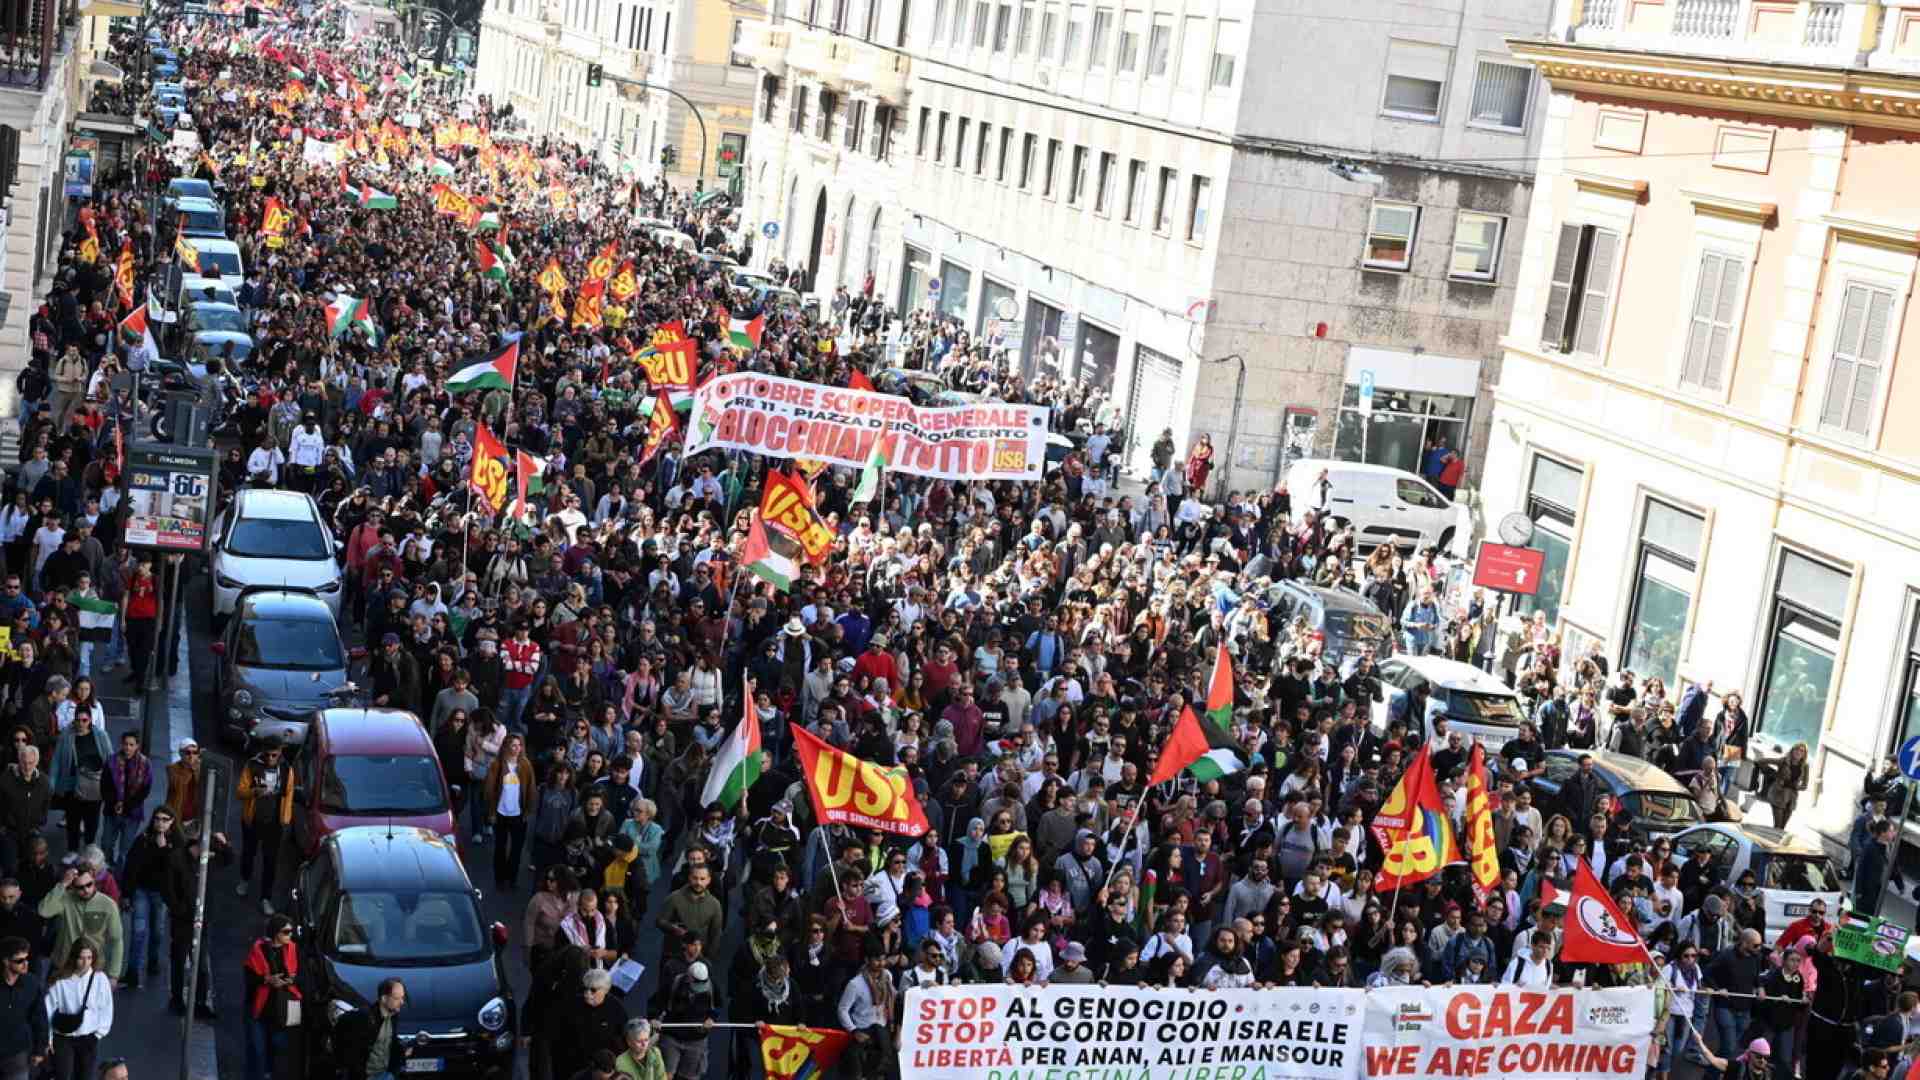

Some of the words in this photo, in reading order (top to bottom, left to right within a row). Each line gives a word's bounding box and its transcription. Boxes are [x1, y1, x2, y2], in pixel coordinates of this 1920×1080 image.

[716, 378, 816, 407] OTTOBRE
[919, 409, 1029, 431] GENERALE
[794, 406, 863, 427] PIAZZA
[901, 435, 990, 474] TUTTO
[994, 450, 1026, 469] USB
[762, 483, 832, 556] USB
[919, 997, 996, 1021] STOP
[1005, 997, 1043, 1019] AL
[1054, 997, 1228, 1021] GENOCIDIO
[1445, 991, 1574, 1040] GAZA
[916, 1021, 994, 1044] STOP
[1003, 1020, 1146, 1042] ACCORDI
[1156, 1022, 1220, 1043] CON
[1228, 1020, 1349, 1045] ISRAELE
[914, 1042, 1013, 1067] LIBERTÀ
[1021, 1047, 1067, 1065] PER
[1075, 1047, 1149, 1068] ANAN,
[1157, 1047, 1195, 1065] ALI
[1201, 1047, 1214, 1063] E
[1220, 1044, 1344, 1067] MANSOUR
[1366, 1045, 1420, 1077] WE
[1425, 1045, 1494, 1077] ARE
[1498, 1043, 1636, 1076] COMING
